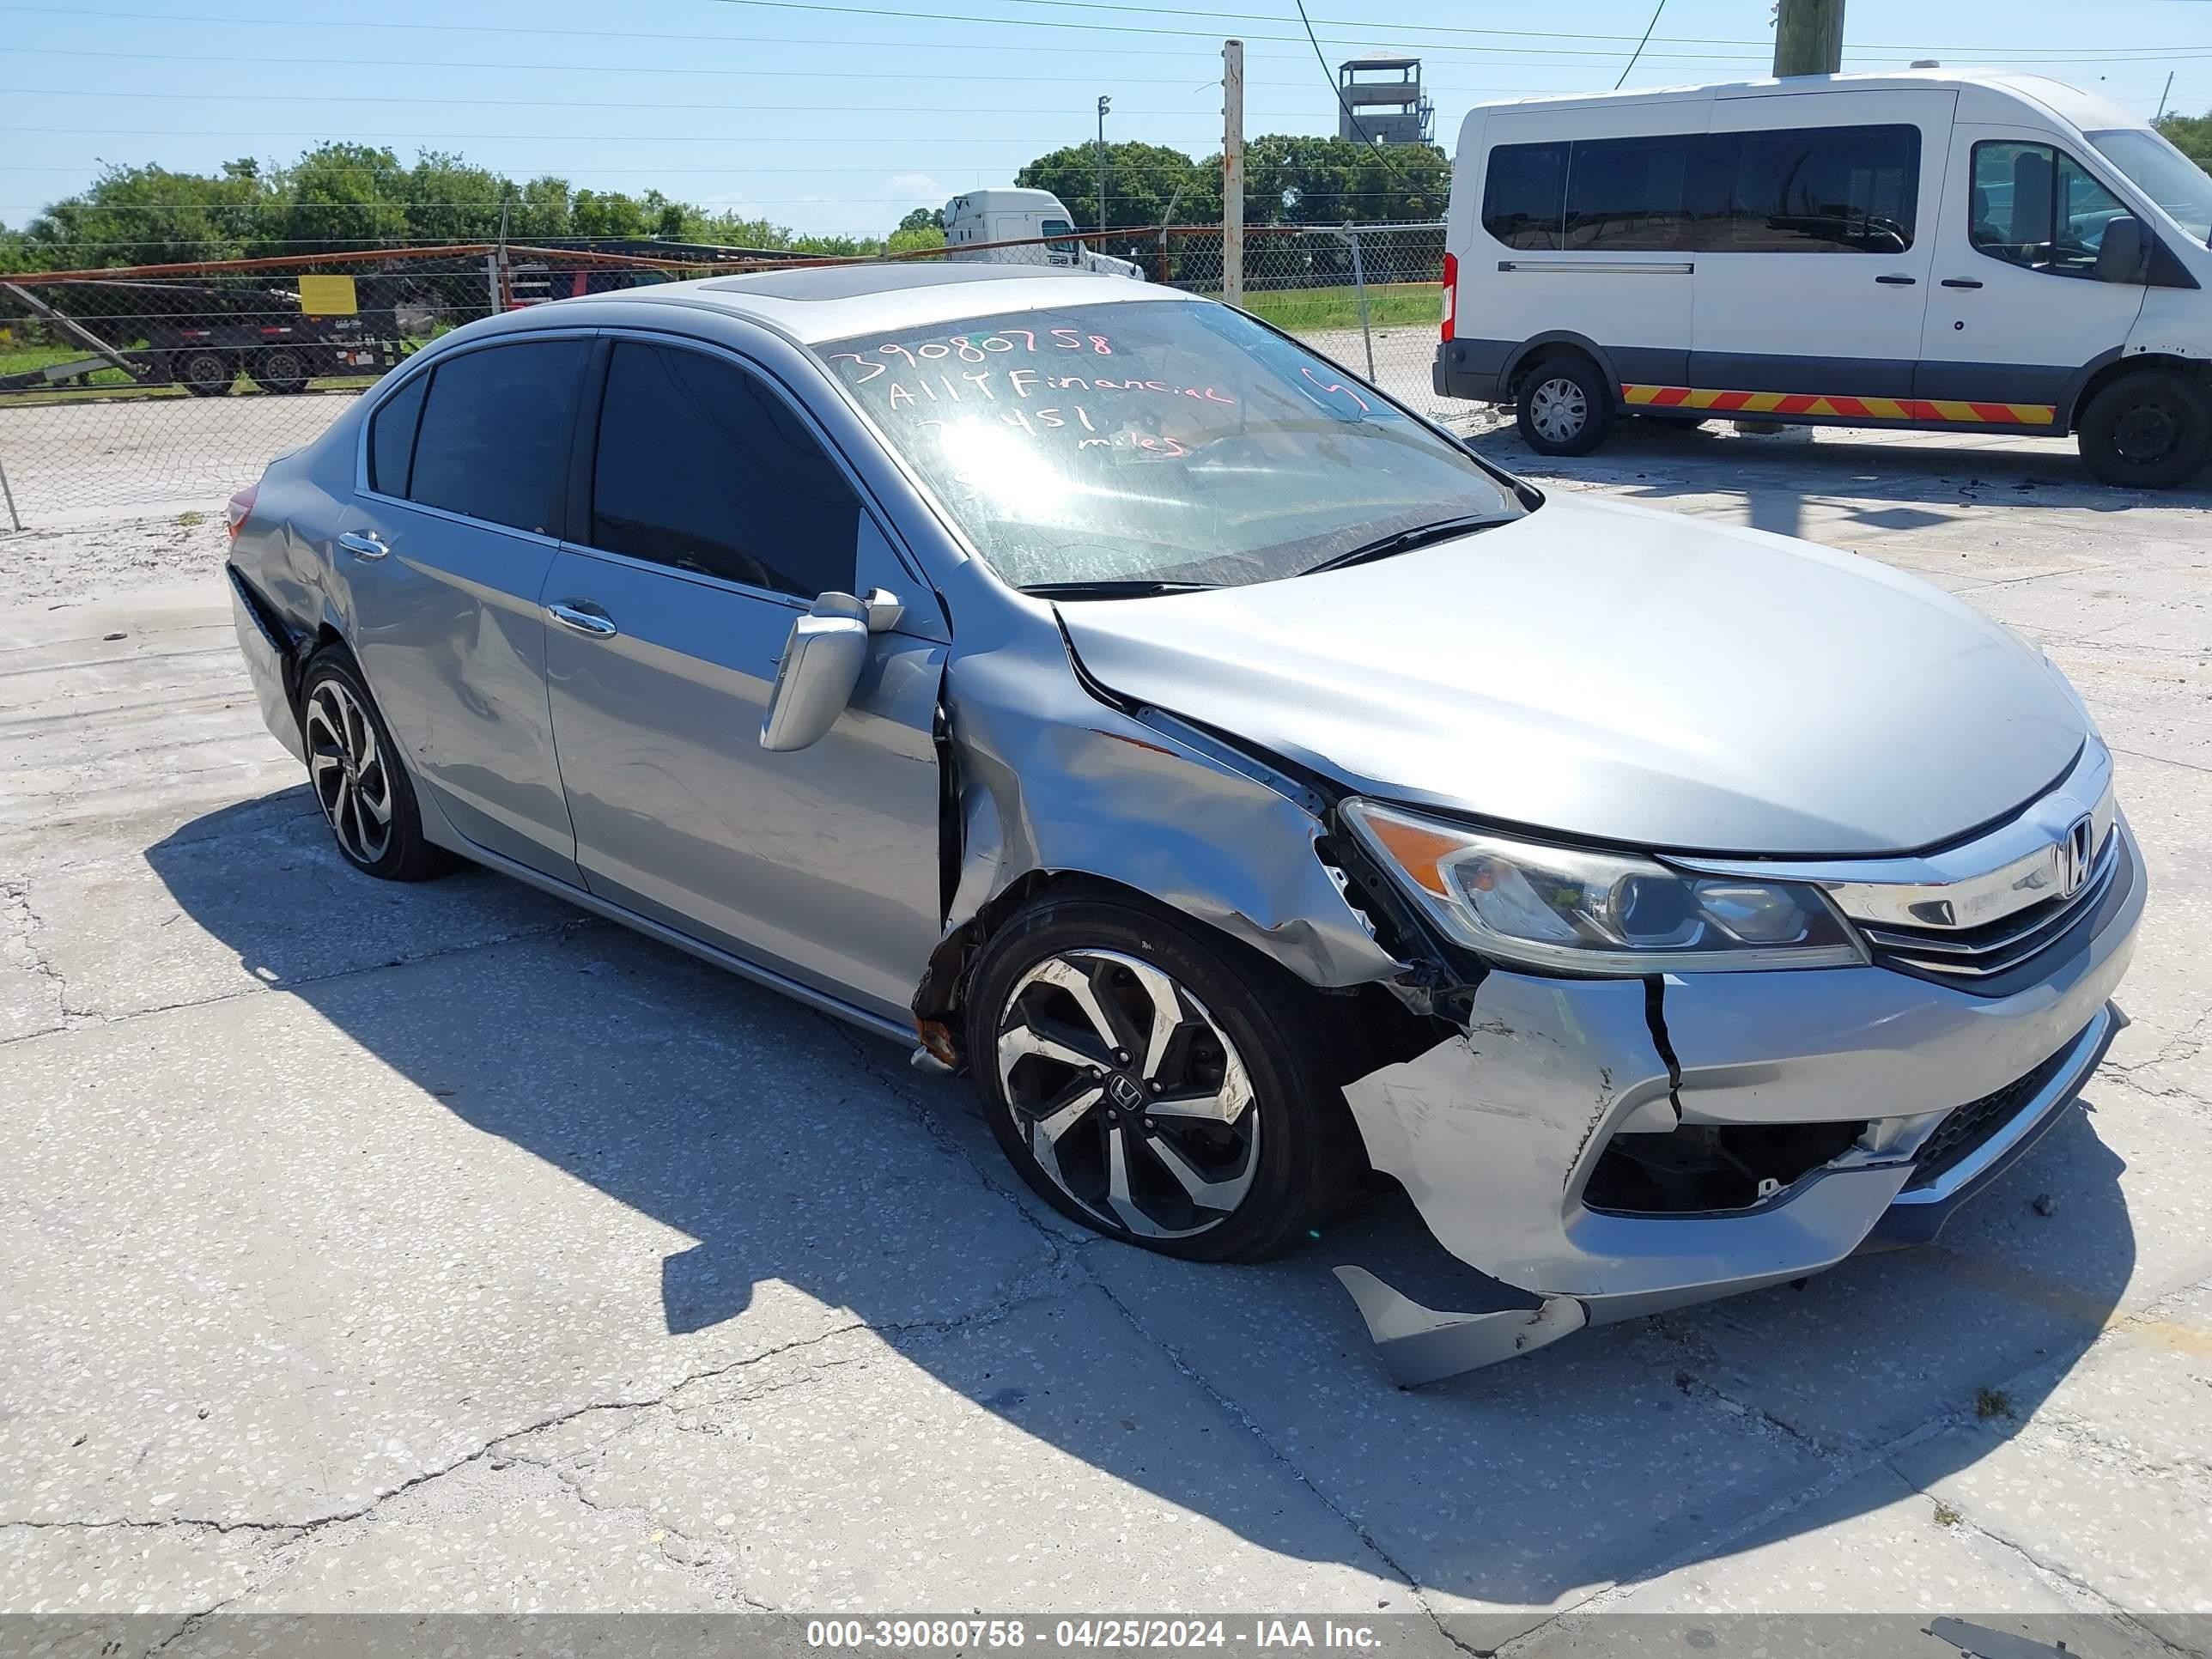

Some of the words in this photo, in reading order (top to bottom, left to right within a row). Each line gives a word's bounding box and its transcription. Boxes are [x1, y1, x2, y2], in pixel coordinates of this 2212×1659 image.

[829, 329, 1112, 384] 39080758
[1008, 369, 1237, 405] Financial
[1078, 431, 1185, 458] miles
